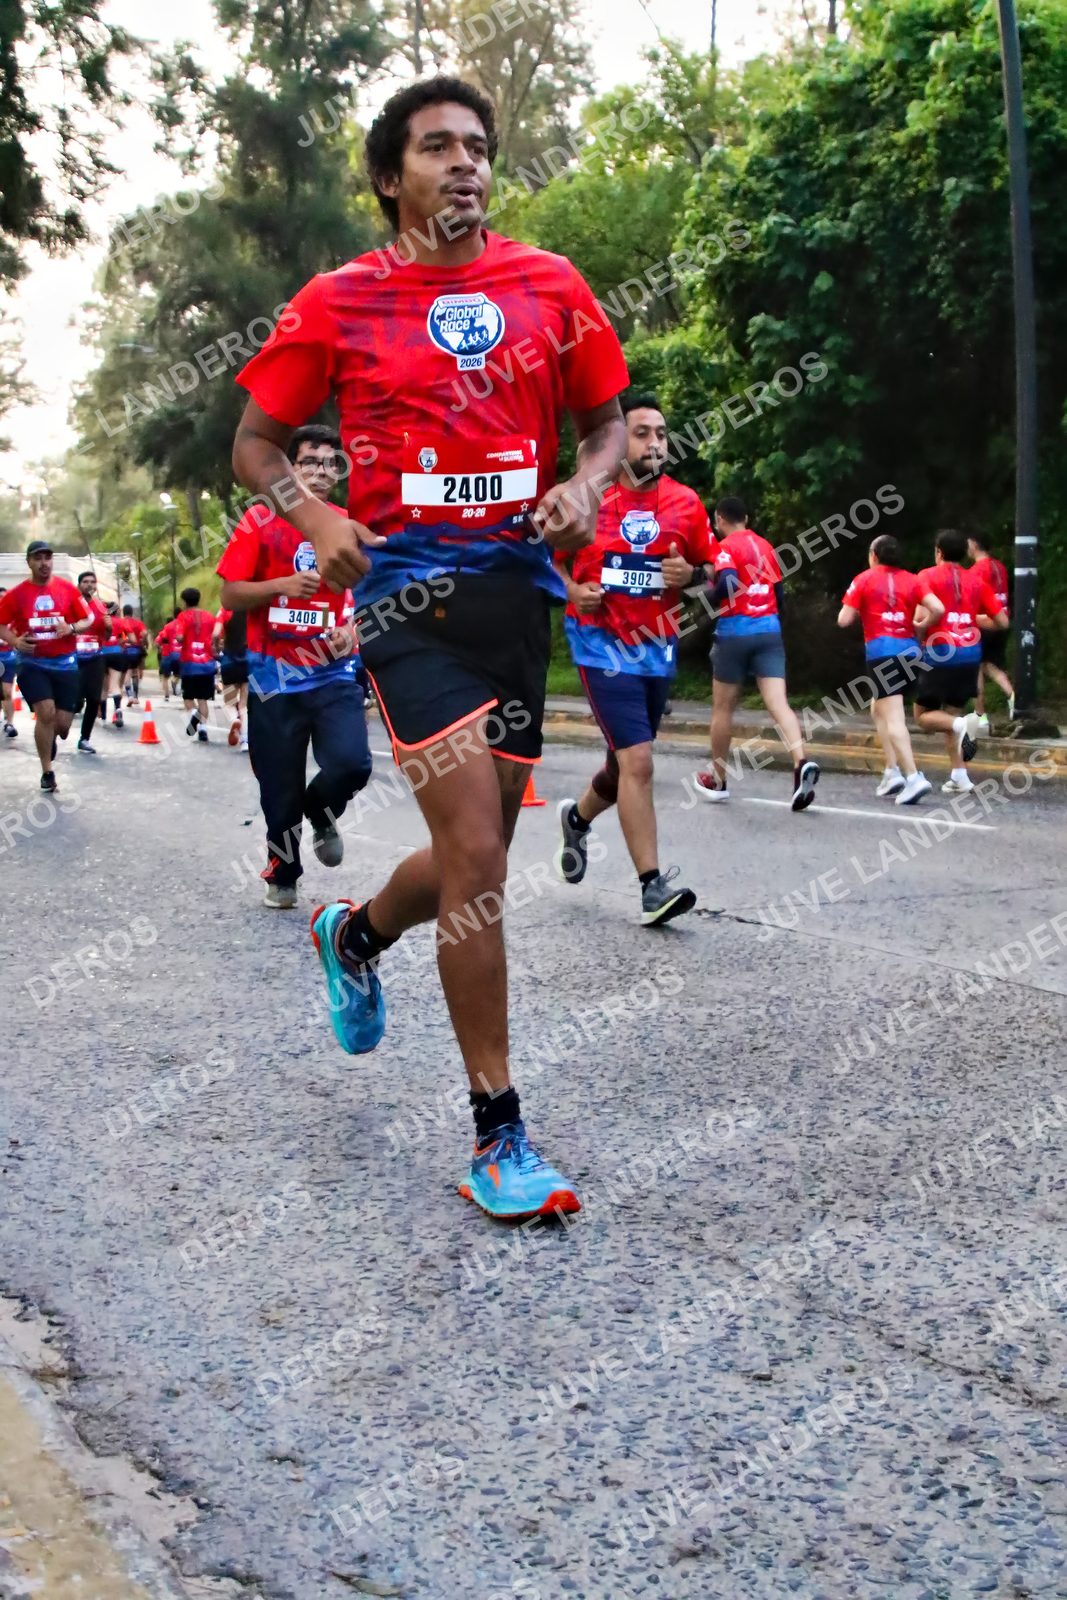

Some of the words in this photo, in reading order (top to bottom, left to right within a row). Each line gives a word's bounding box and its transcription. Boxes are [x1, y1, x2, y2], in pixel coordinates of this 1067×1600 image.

[445, 305, 484, 321] Global
[440, 319, 471, 333] Race
[460, 357, 483, 368] 2026
[443, 474, 503, 503] 2400
[622, 571, 653, 587] 3902
[288, 610, 318, 625] 3408
